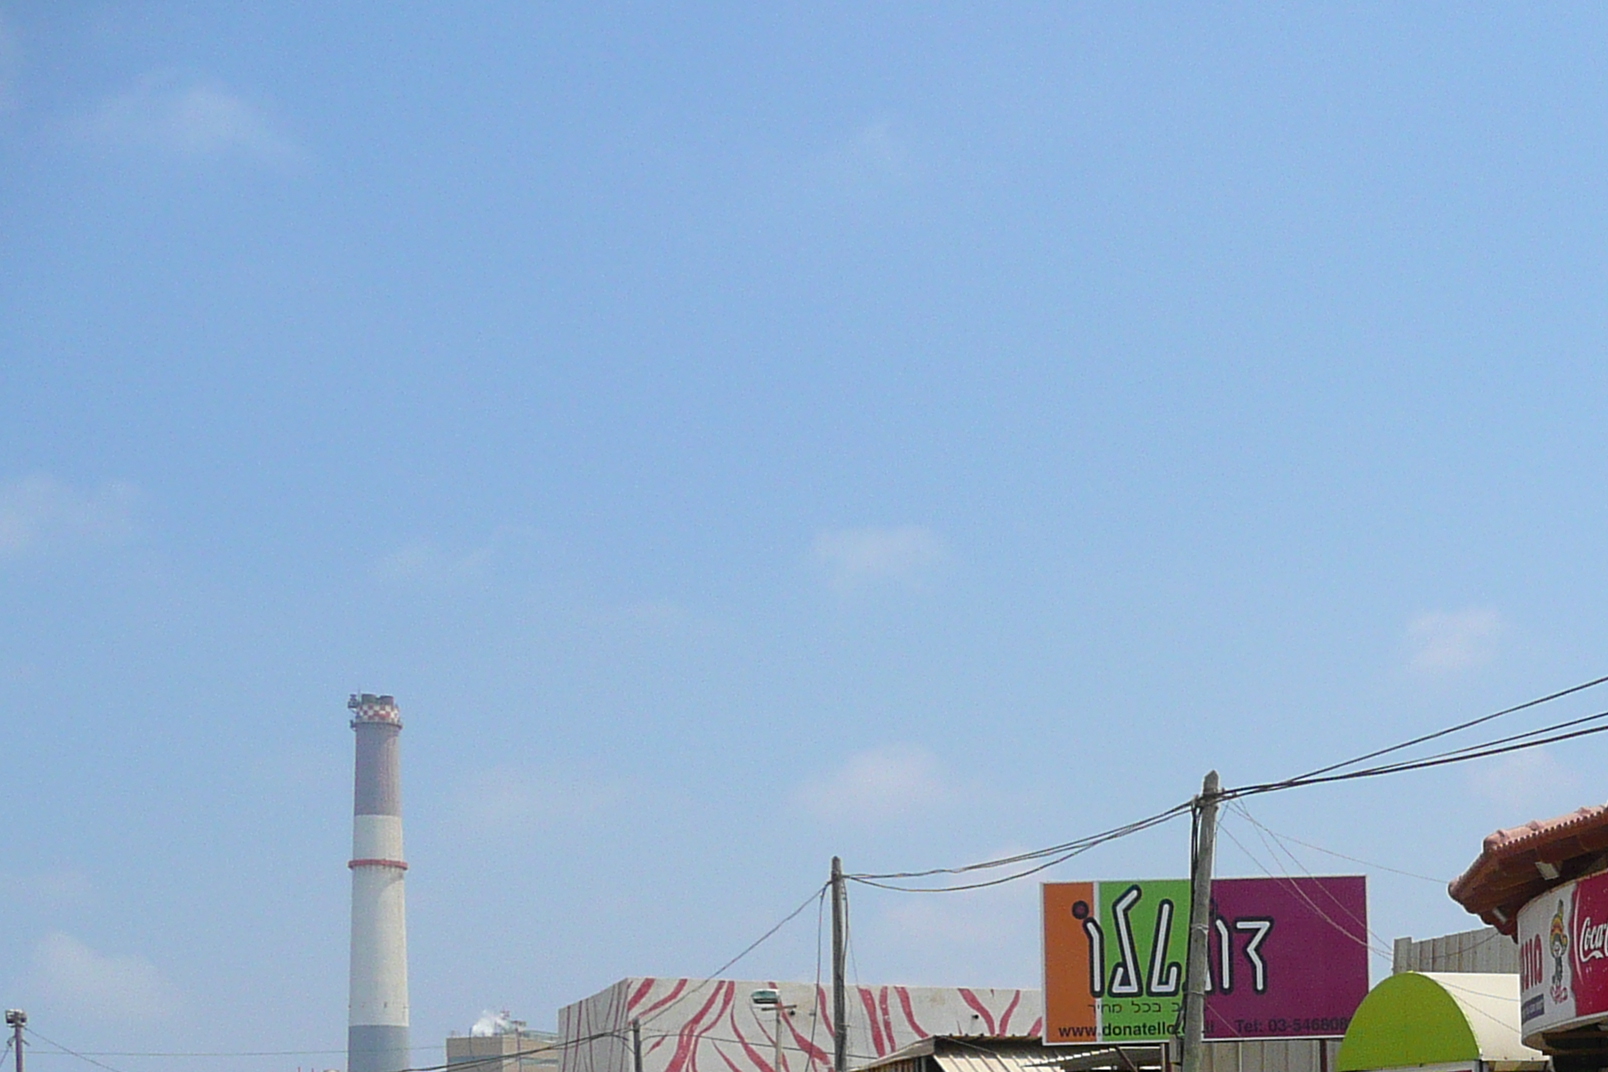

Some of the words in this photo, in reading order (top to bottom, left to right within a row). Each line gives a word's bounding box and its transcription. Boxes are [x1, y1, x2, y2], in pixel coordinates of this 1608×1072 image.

[1071, 884, 1275, 998] דוטלו
[1087, 1001, 1122, 1014] מחיר
[1131, 1001, 1162, 1013] בכל
